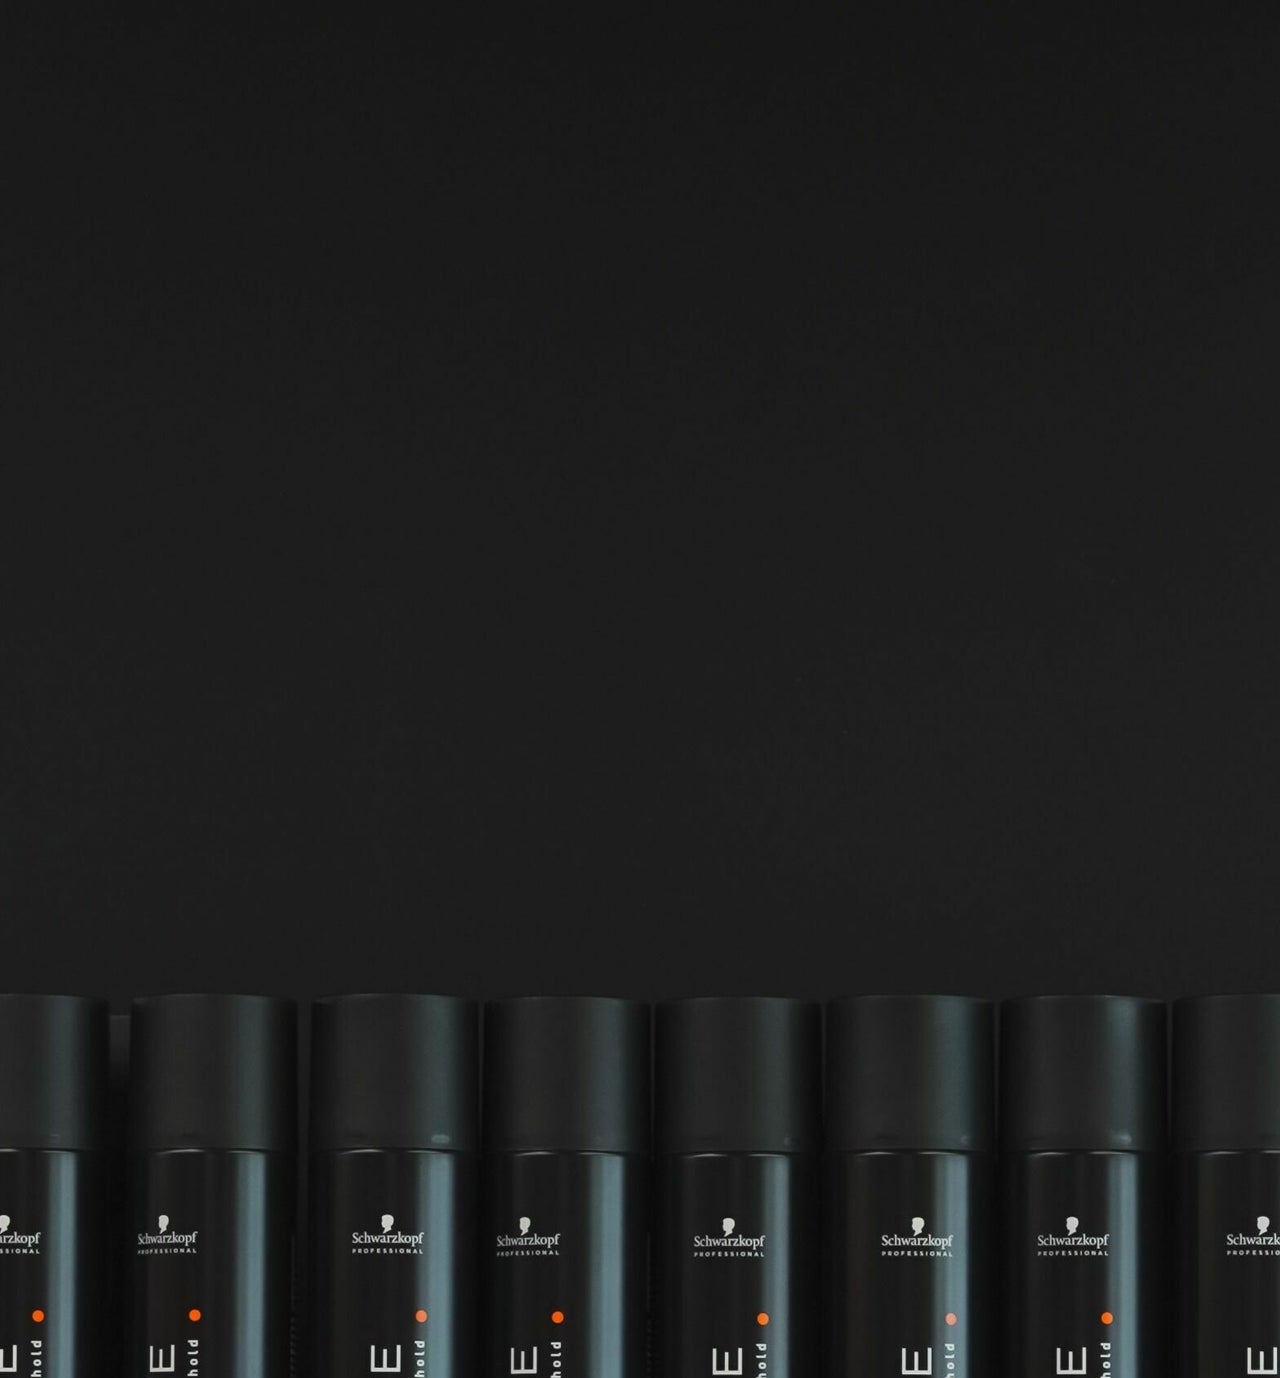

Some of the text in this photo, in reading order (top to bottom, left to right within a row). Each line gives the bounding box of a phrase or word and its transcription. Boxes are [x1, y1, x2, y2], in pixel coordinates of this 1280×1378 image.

[138, 1231, 198, 1246] Schwarzkopf
[352, 1231, 424, 1247] Schwarzkopf
[496, 1233, 560, 1248] Schwarzkopf
[694, 1235, 765, 1250] Schwarzkopf
[881, 1234, 953, 1249] Schwarzkopf
[1037, 1234, 1109, 1249] Schwarzkopf
[29, 1340, 42, 1377] hold
[186, 1340, 199, 1377] hold
[413, 1341, 425, 1377] hold
[549, 1342, 561, 1378] hold
[1099, 1342, 1111, 1378] hold
